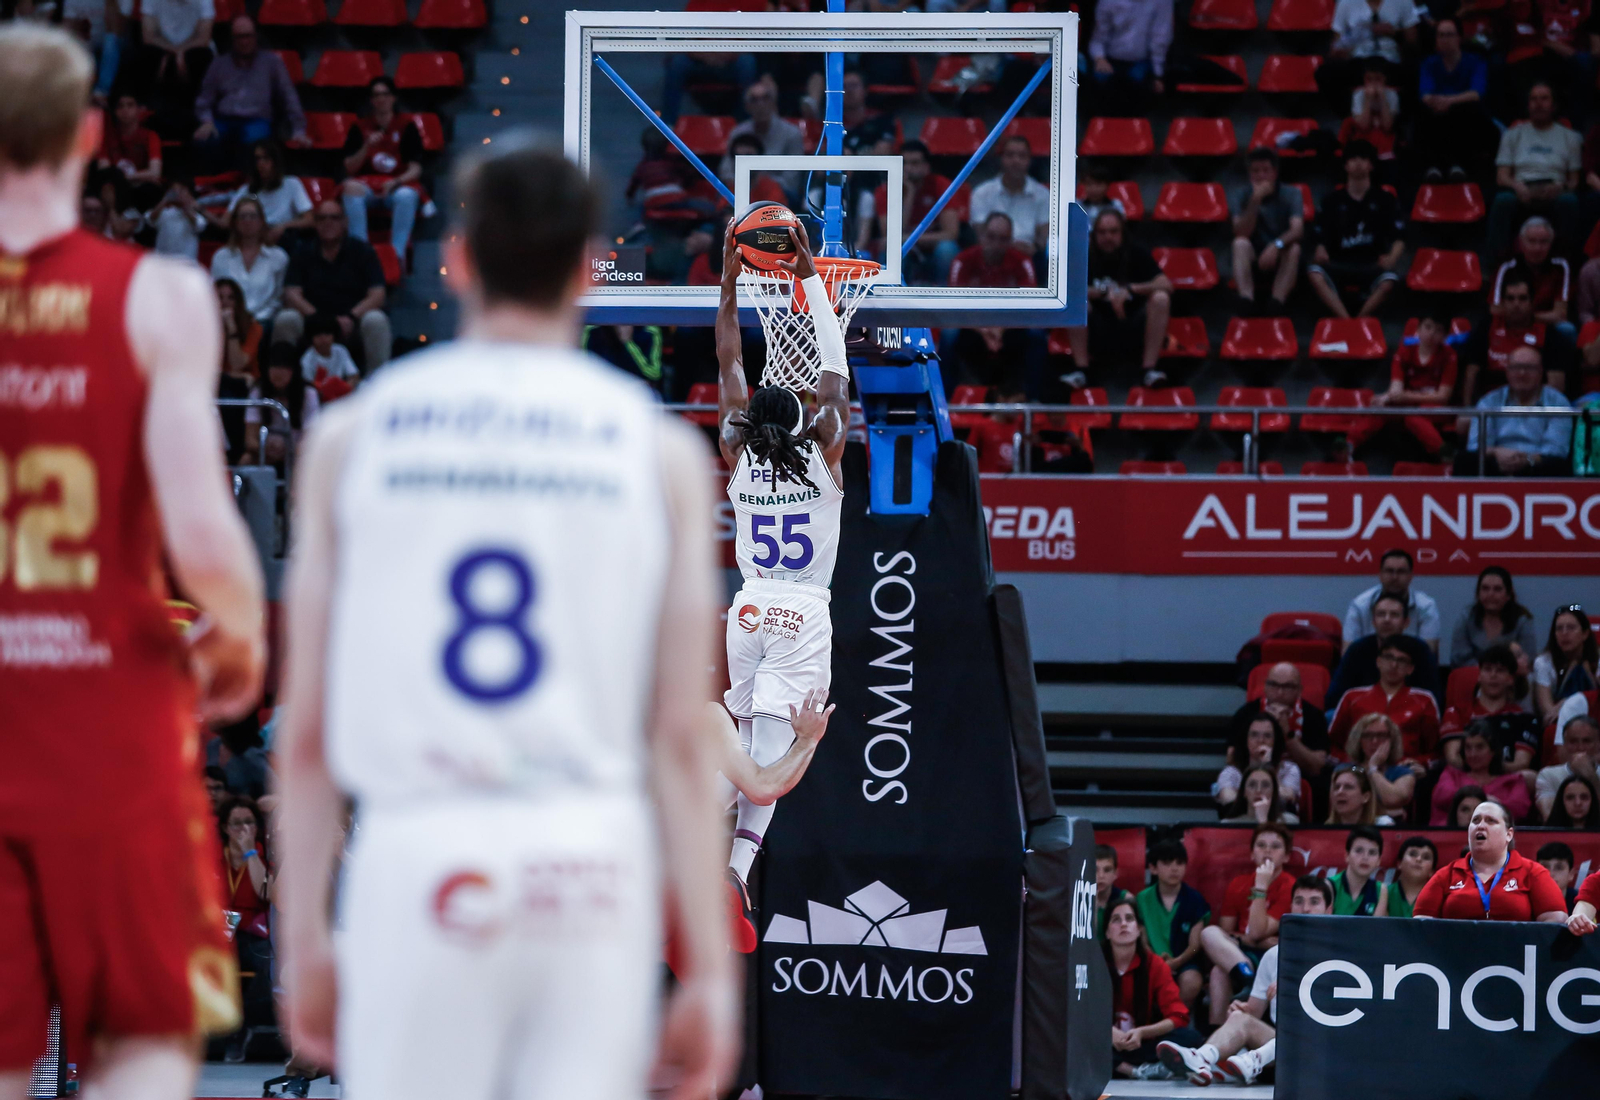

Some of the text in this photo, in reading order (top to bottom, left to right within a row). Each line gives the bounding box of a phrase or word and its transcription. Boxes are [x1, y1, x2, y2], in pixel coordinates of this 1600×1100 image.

[592, 258, 615, 271] liga
[592, 270, 643, 281] endesa
[739, 488, 821, 505] BENAHAVÍS
[751, 513, 814, 570] 55
[1028, 540, 1076, 560] BUS
[1345, 548, 1470, 562] MDA
[767, 607, 804, 624] COSTA
[441, 547, 543, 704] 8
[763, 618, 800, 633] DEL SOL
[863, 550, 916, 804] SOMMOS
[772, 956, 975, 1004] SOMMOS
